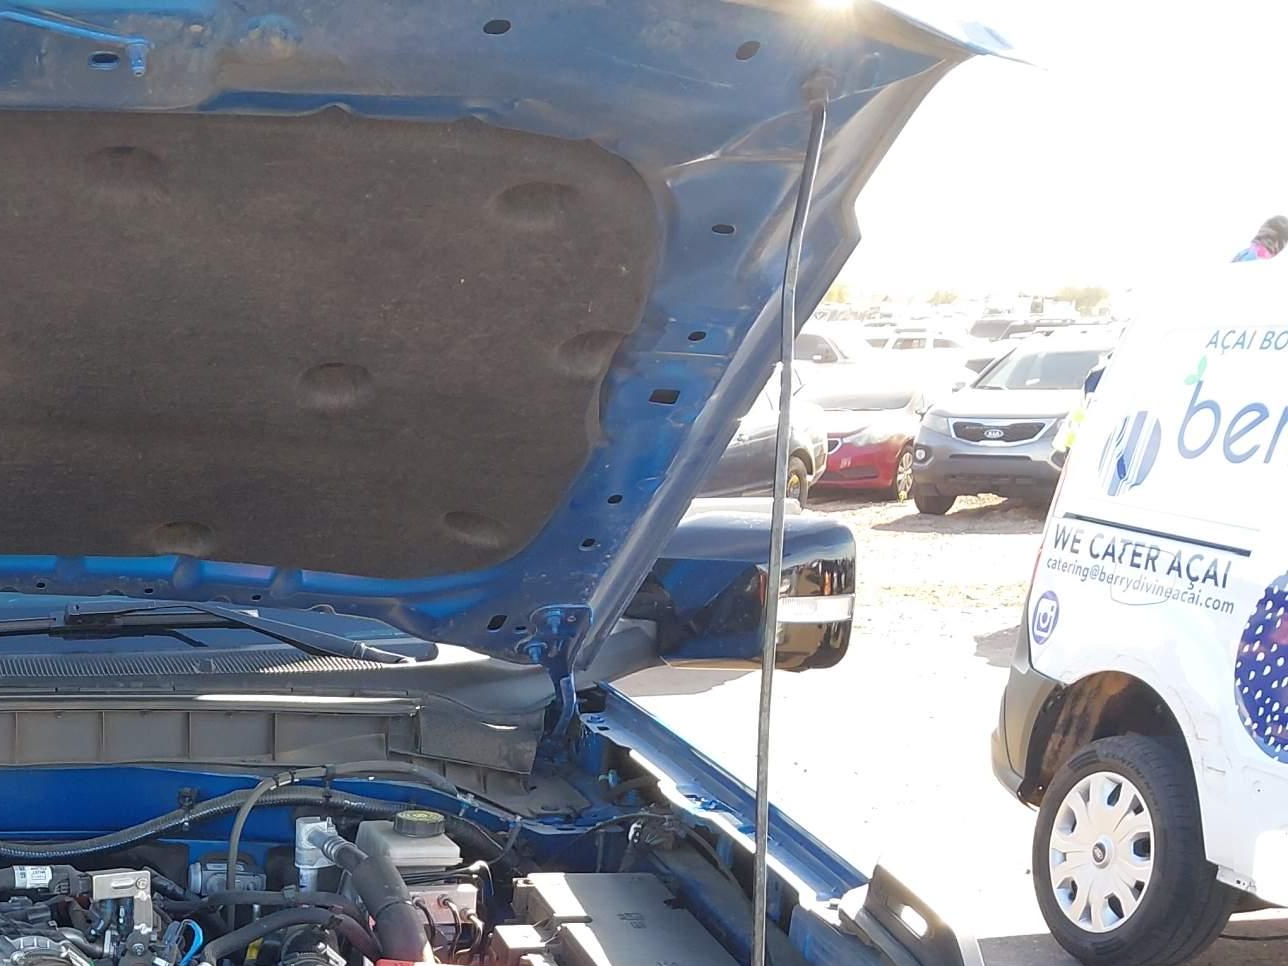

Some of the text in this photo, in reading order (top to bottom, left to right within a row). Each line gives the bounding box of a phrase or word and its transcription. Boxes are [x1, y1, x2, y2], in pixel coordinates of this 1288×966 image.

[1053, 524, 1232, 590] WE CATER AÇAI
